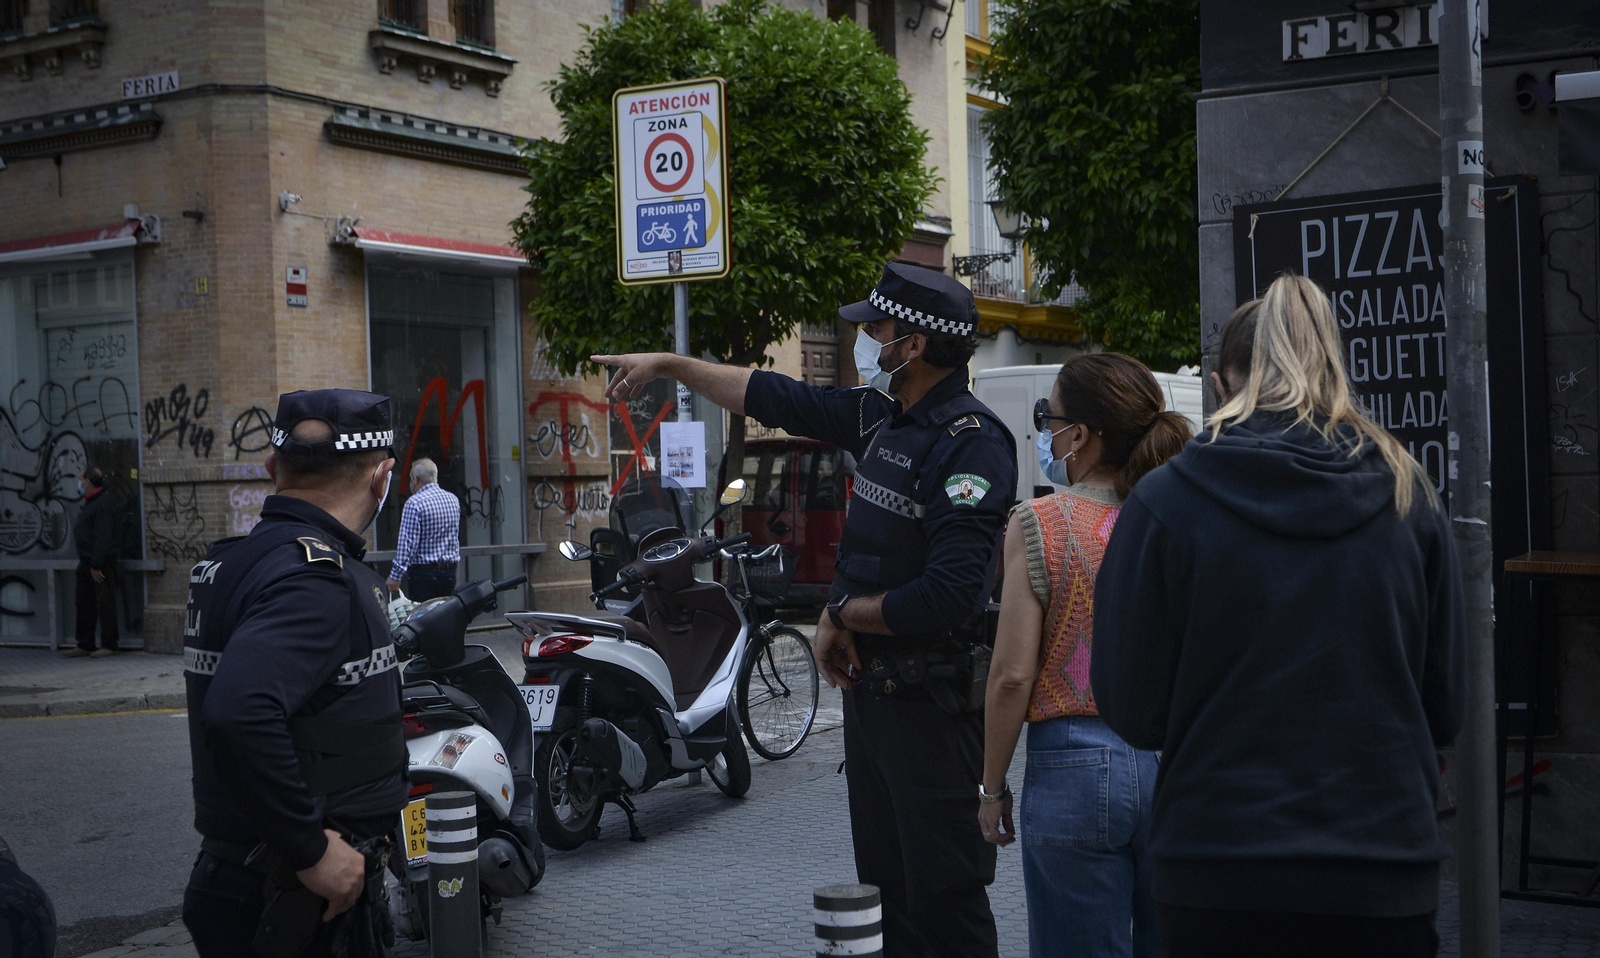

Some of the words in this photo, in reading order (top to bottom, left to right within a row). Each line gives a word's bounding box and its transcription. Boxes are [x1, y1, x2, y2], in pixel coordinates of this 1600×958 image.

[1286, 4, 1436, 61] FERI
[122, 74, 176, 97] FERIA
[629, 91, 710, 115] ATENCIÓN
[648, 117, 688, 132] ZONA
[655, 151, 684, 173] 20
[641, 202, 701, 217] PRIORIDAD
[1331, 282, 1448, 329] SALADA
[1349, 332, 1448, 382] GUETT
[1352, 390, 1448, 430] HILADA
[877, 447, 912, 470] POLICIA
[410, 822, 426, 836] 42
[411, 837, 426, 851] BV
